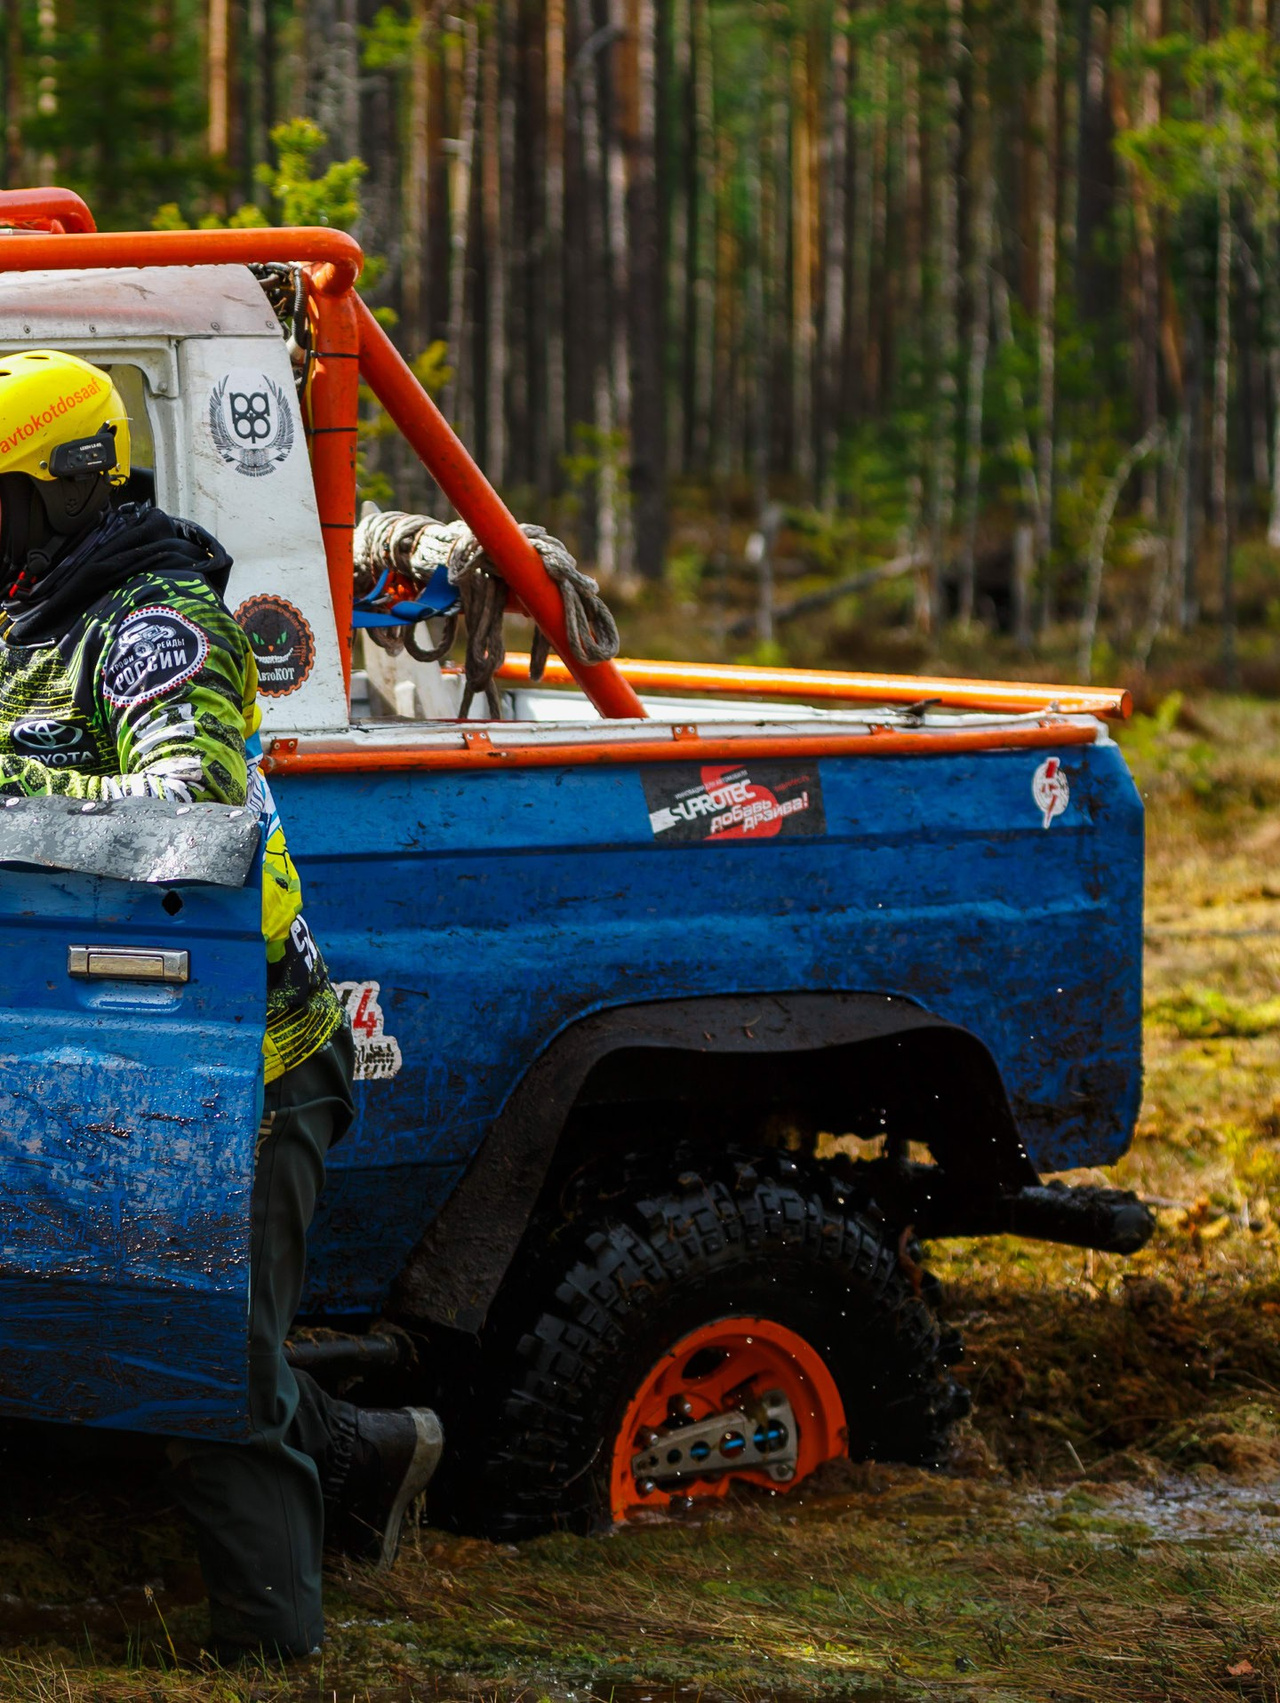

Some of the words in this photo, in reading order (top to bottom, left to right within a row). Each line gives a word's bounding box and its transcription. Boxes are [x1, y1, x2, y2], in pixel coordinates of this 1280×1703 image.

[110, 655, 134, 673] ТРОФИ
[156, 638, 185, 650] РЕЙДЫ
[116, 649, 187, 690] РОССИИ
